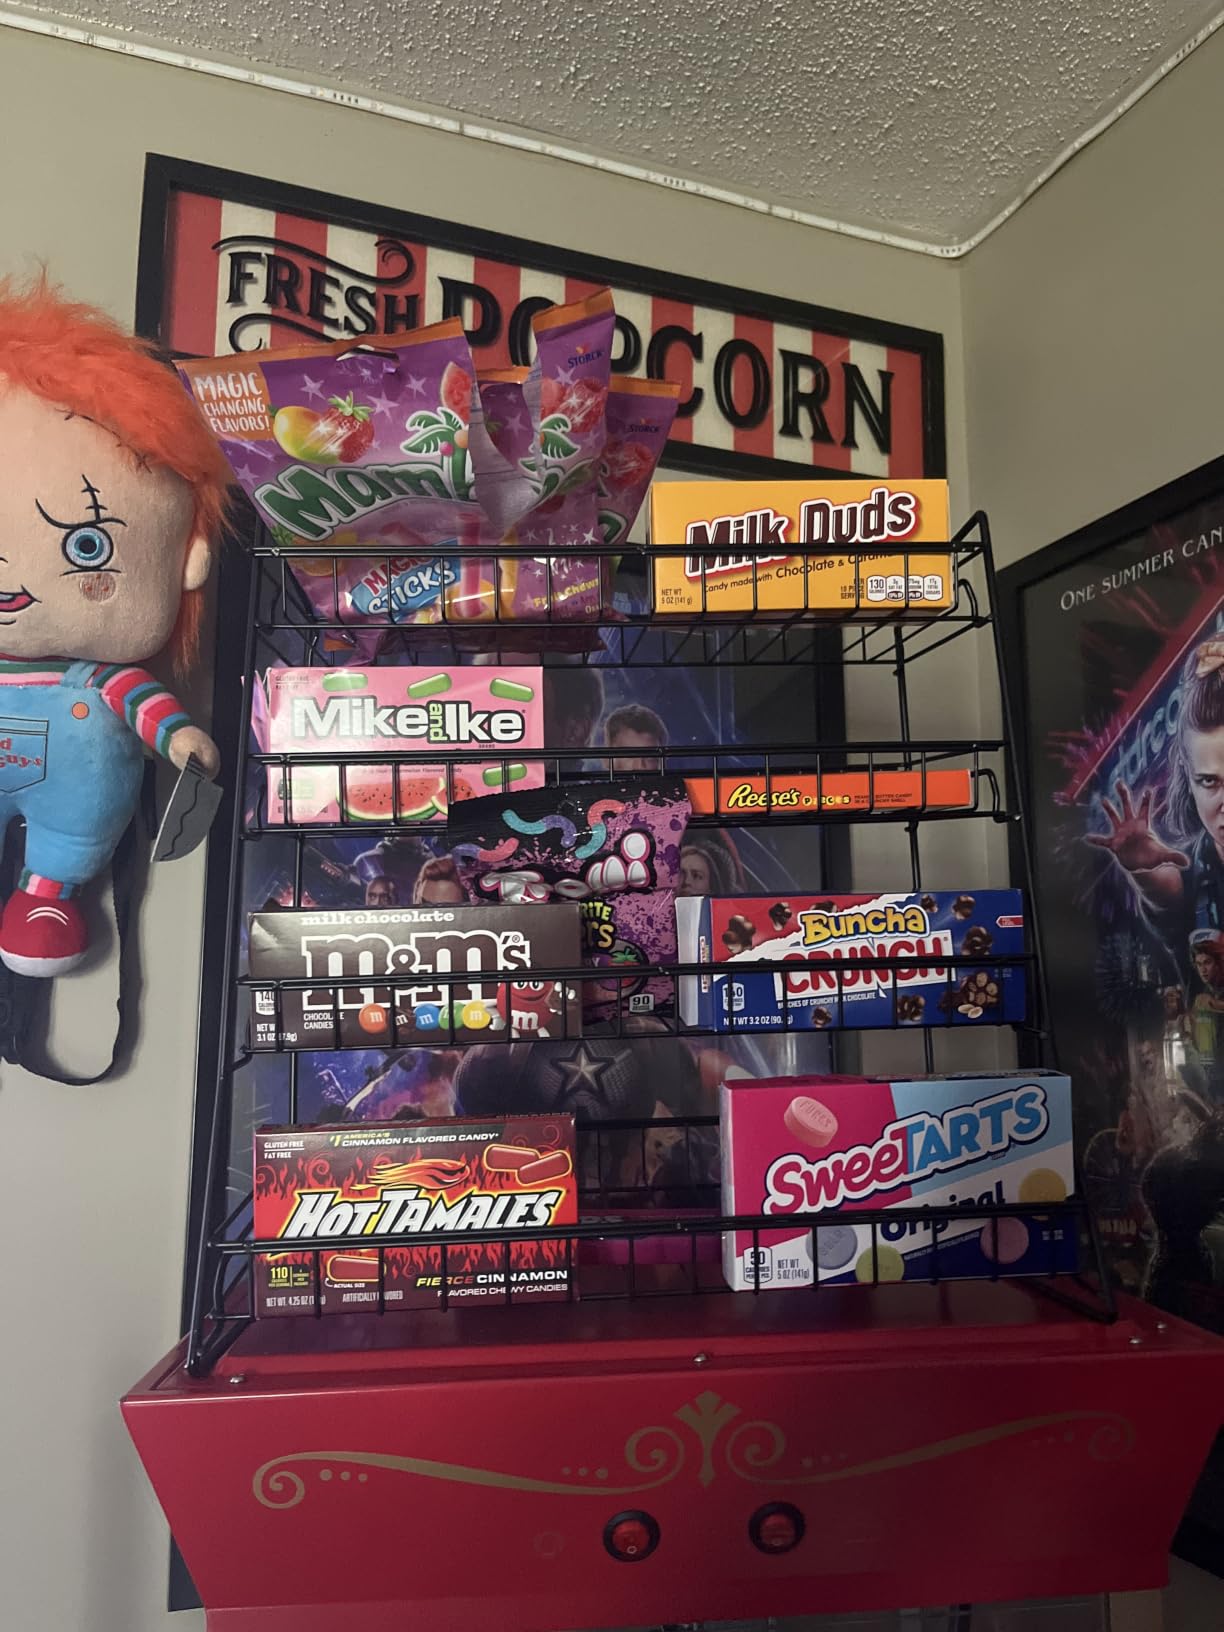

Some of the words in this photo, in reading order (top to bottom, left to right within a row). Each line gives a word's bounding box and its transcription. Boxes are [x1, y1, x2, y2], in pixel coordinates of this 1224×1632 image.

[226, 252, 420, 336] FRESH
[568, 349, 603, 368] STORCK
[194, 372, 263, 401] MAGIC
[203, 397, 266, 418] CHANGING
[210, 415, 271, 433] FLAVORS!
[629, 424, 659, 433] STORCK
[687, 512, 788, 575] Milk
[802, 489, 916, 546] Duds
[1060, 584, 1095, 611] ONE
[1101, 549, 1175, 594] SUMMER
[1182, 526, 1224, 558] CAN
[704, 582, 729, 593] Candy
[730, 577, 754, 588] made
[756, 573, 773, 584] with
[776, 560, 835, 578] Chocolate
[368, 561, 456, 615] STICKS
[870, 579, 884, 589] 130
[293, 696, 428, 738] Mike
[430, 702, 447, 741] and
[445, 703, 523, 741] Ike
[727, 783, 802, 808] Reese's
[301, 912, 352, 926] milk
[354, 910, 455, 925] chocolate
[801, 906, 926, 946] Buncha
[783, 936, 945, 994] CRUNCH
[633, 995, 650, 1005] 90
[304, 1012, 344, 1021] CHOCOLE
[723, 1017, 737, 1025] NT
[738, 1016, 748, 1025] WT
[749, 1016, 759, 1025] 3.2
[760, 1016, 770, 1024] OZ
[256, 1024, 266, 1032] NET
[304, 1022, 334, 1030] CANDIES
[341, 1137, 401, 1147] CINNAMON
[402, 1134, 457, 1144] FLAVORED
[343, 1132, 391, 1140] AMERICA'S
[264, 1141, 288, 1149] GLUTEN
[289, 1140, 304, 1148] FREE
[276, 1151, 292, 1159] FREE
[777, 1259, 788, 1268] NET
[789, 1258, 800, 1268] WT
[270, 1266, 288, 1279] 110
[782, 1269, 791, 1279] OZ
[437, 1287, 488, 1297] FAVORED
[526, 1283, 568, 1293] CANDIES
[342, 1292, 376, 1303] ARTIFICIALLY
